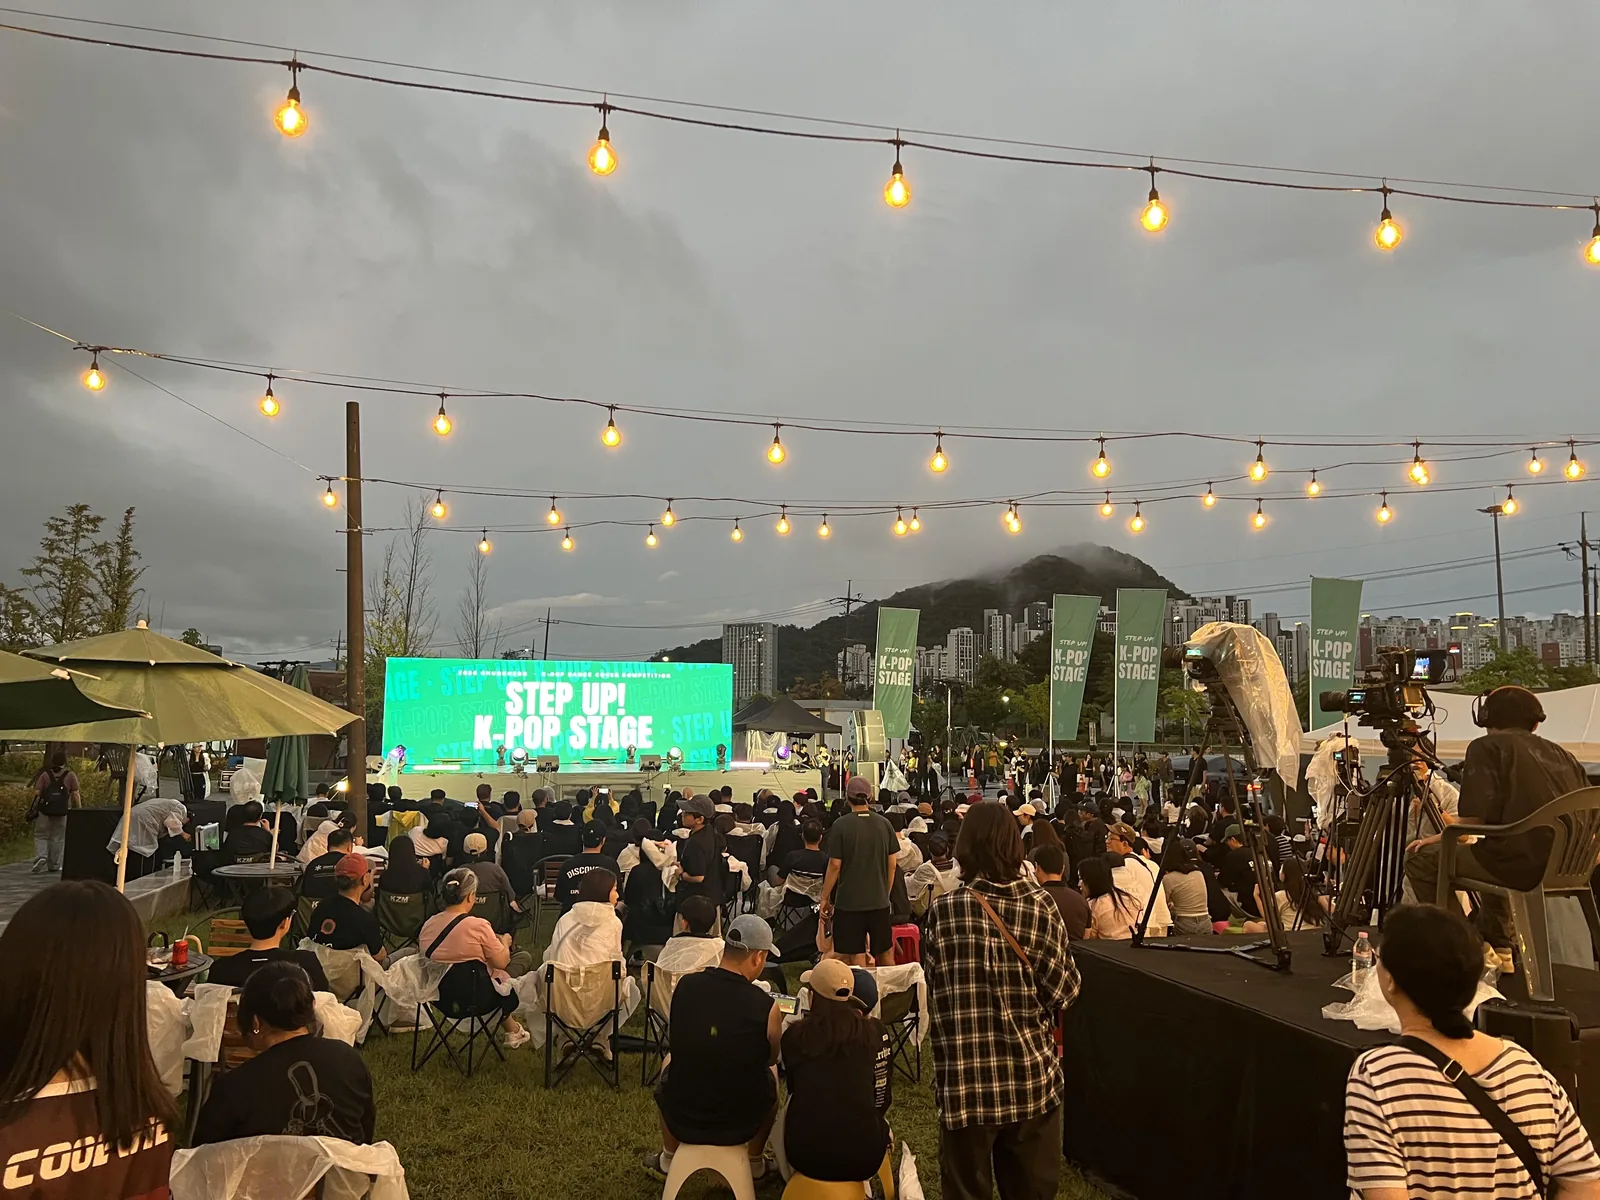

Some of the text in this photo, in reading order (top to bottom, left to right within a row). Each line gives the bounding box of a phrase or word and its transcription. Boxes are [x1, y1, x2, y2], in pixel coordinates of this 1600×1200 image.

[1317, 628, 1333, 636] STEP
[1119, 645, 1158, 662] K-POP
[1313, 639, 1352, 659] K-POP
[880, 655, 912, 671] K-POP
[1118, 662, 1156, 680] STAGE
[1313, 659, 1350, 679] STAGE
[879, 670, 911, 686] STAGE
[505, 681, 626, 716] STEP UP!
[473, 715, 561, 750] K-POP
[569, 715, 653, 750] STAGE
[390, 895, 410, 904] KZM
